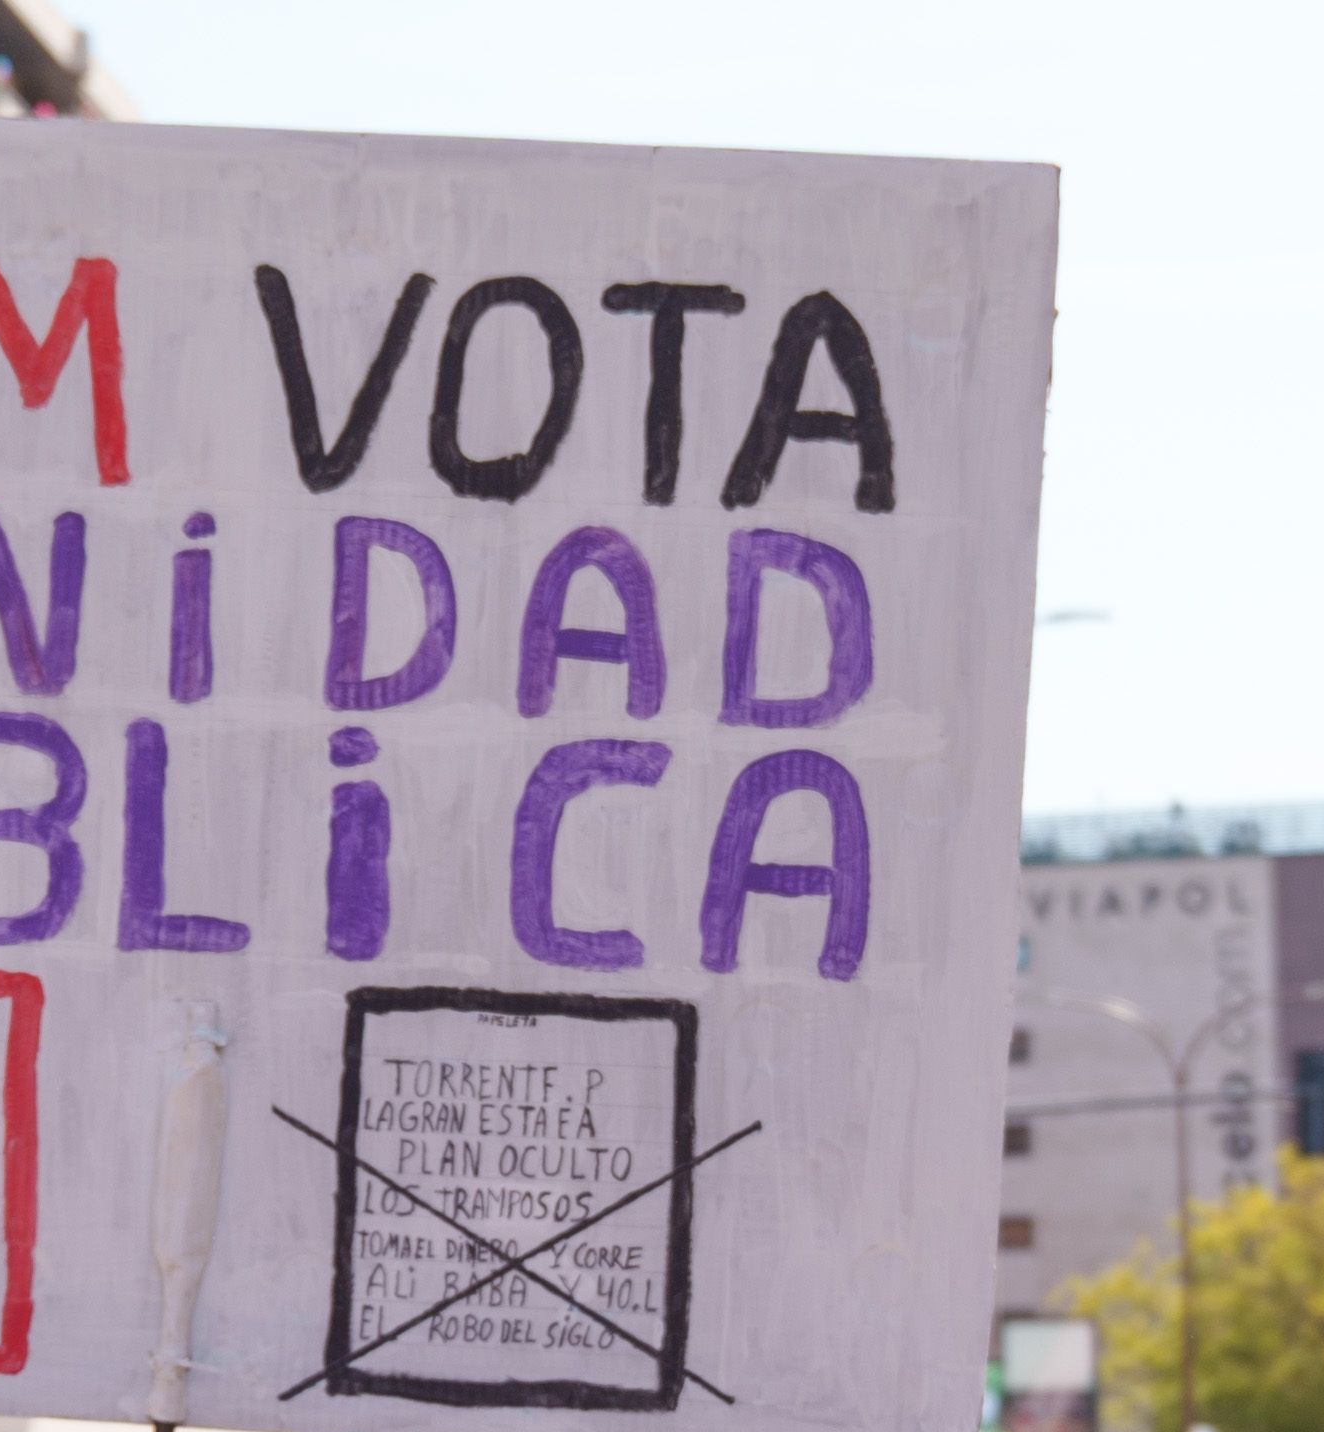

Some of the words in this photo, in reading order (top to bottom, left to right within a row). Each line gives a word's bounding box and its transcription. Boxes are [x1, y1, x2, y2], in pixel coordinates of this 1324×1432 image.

[255, 264, 896, 513] VOTA
[1028, 877, 1256, 921] VIAPOL
[584, 1069, 604, 1104] P
[398, 1139, 481, 1178] PLAN
[498, 1144, 633, 1182] OCULTO
[362, 1180, 421, 1216] LOS
[434, 1186, 594, 1224] TRAMPOSOS
[548, 1242, 570, 1270] Y
[575, 1241, 643, 1270] CORRE
[443, 1270, 528, 1308] BABA
[359, 1304, 396, 1341] EL
[429, 1312, 494, 1343] ROBO
[500, 1319, 537, 1344] DEL
